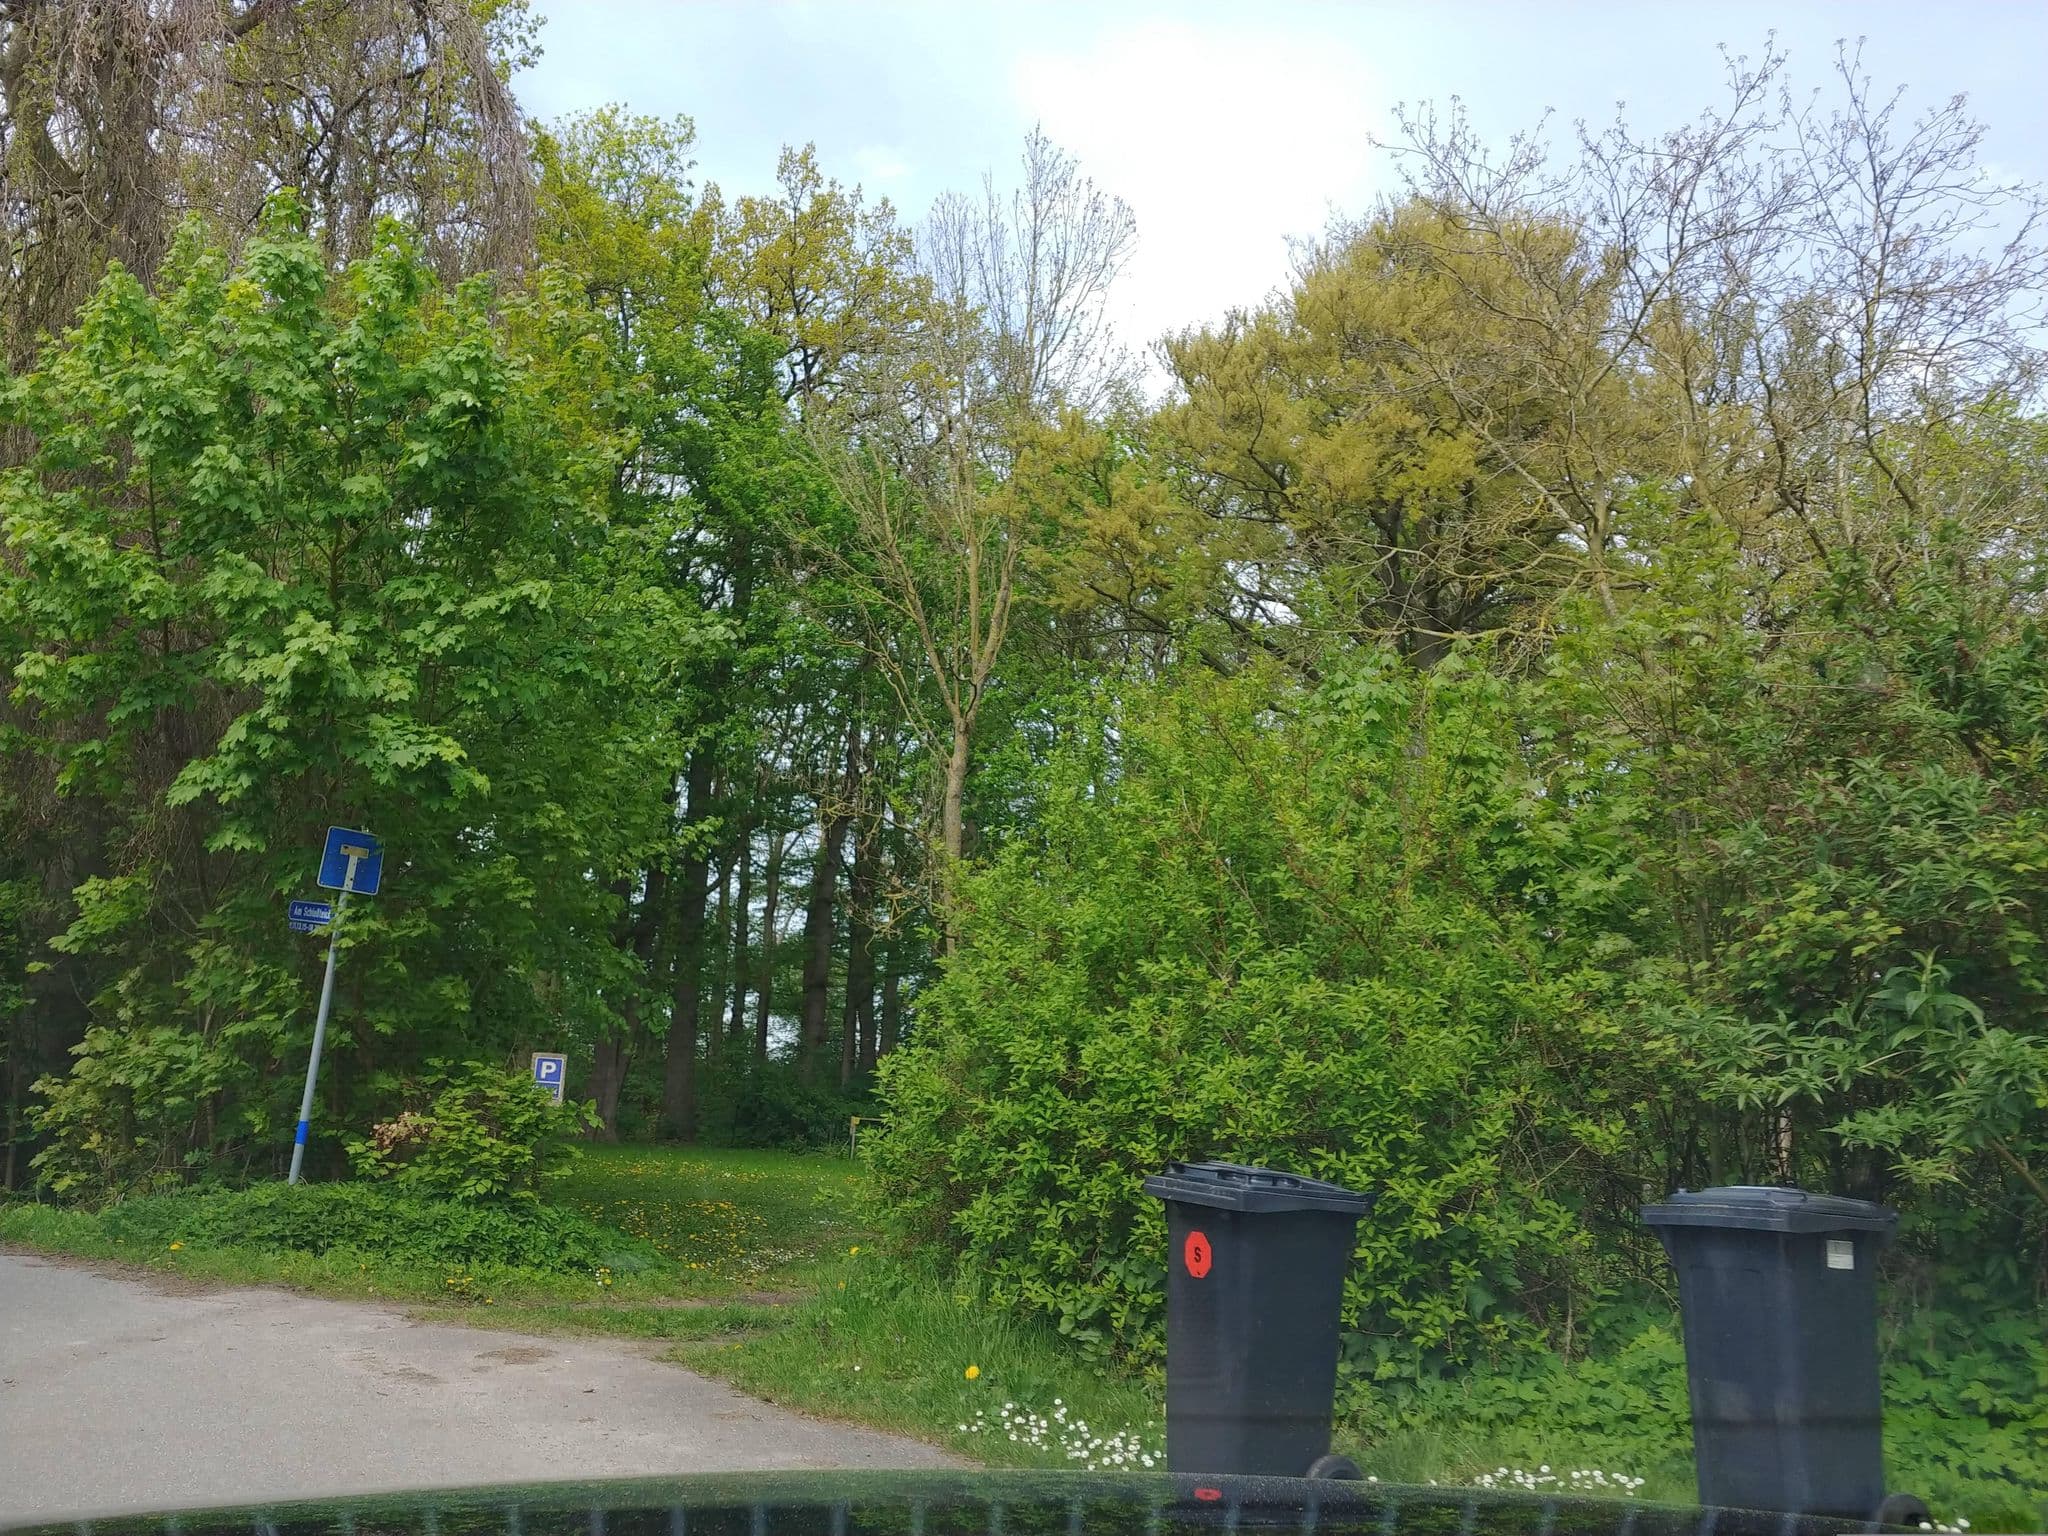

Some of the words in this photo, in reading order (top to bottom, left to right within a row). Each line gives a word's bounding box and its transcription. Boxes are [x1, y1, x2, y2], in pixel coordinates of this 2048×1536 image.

[294, 906, 302, 916] Am
[541, 1062, 556, 1079] P
[1194, 1247, 1201, 1263] S
